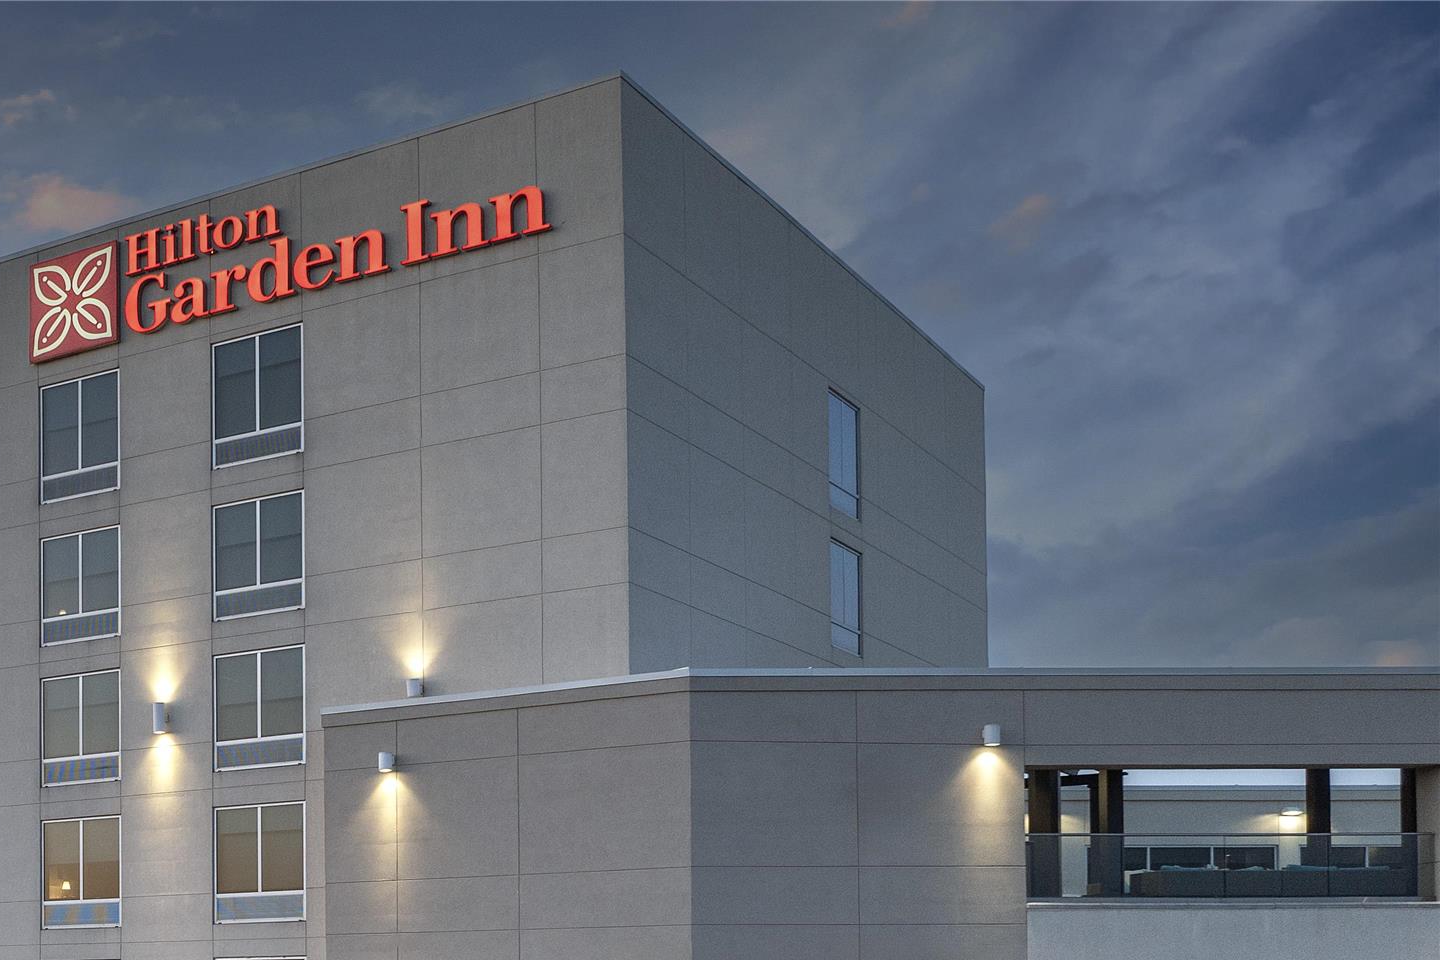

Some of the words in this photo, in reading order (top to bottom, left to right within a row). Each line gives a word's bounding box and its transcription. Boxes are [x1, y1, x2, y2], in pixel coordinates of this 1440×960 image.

[124, 236, 391, 334] Garden
[400, 185, 552, 266] Inn
[125, 204, 282, 276] Hilton
